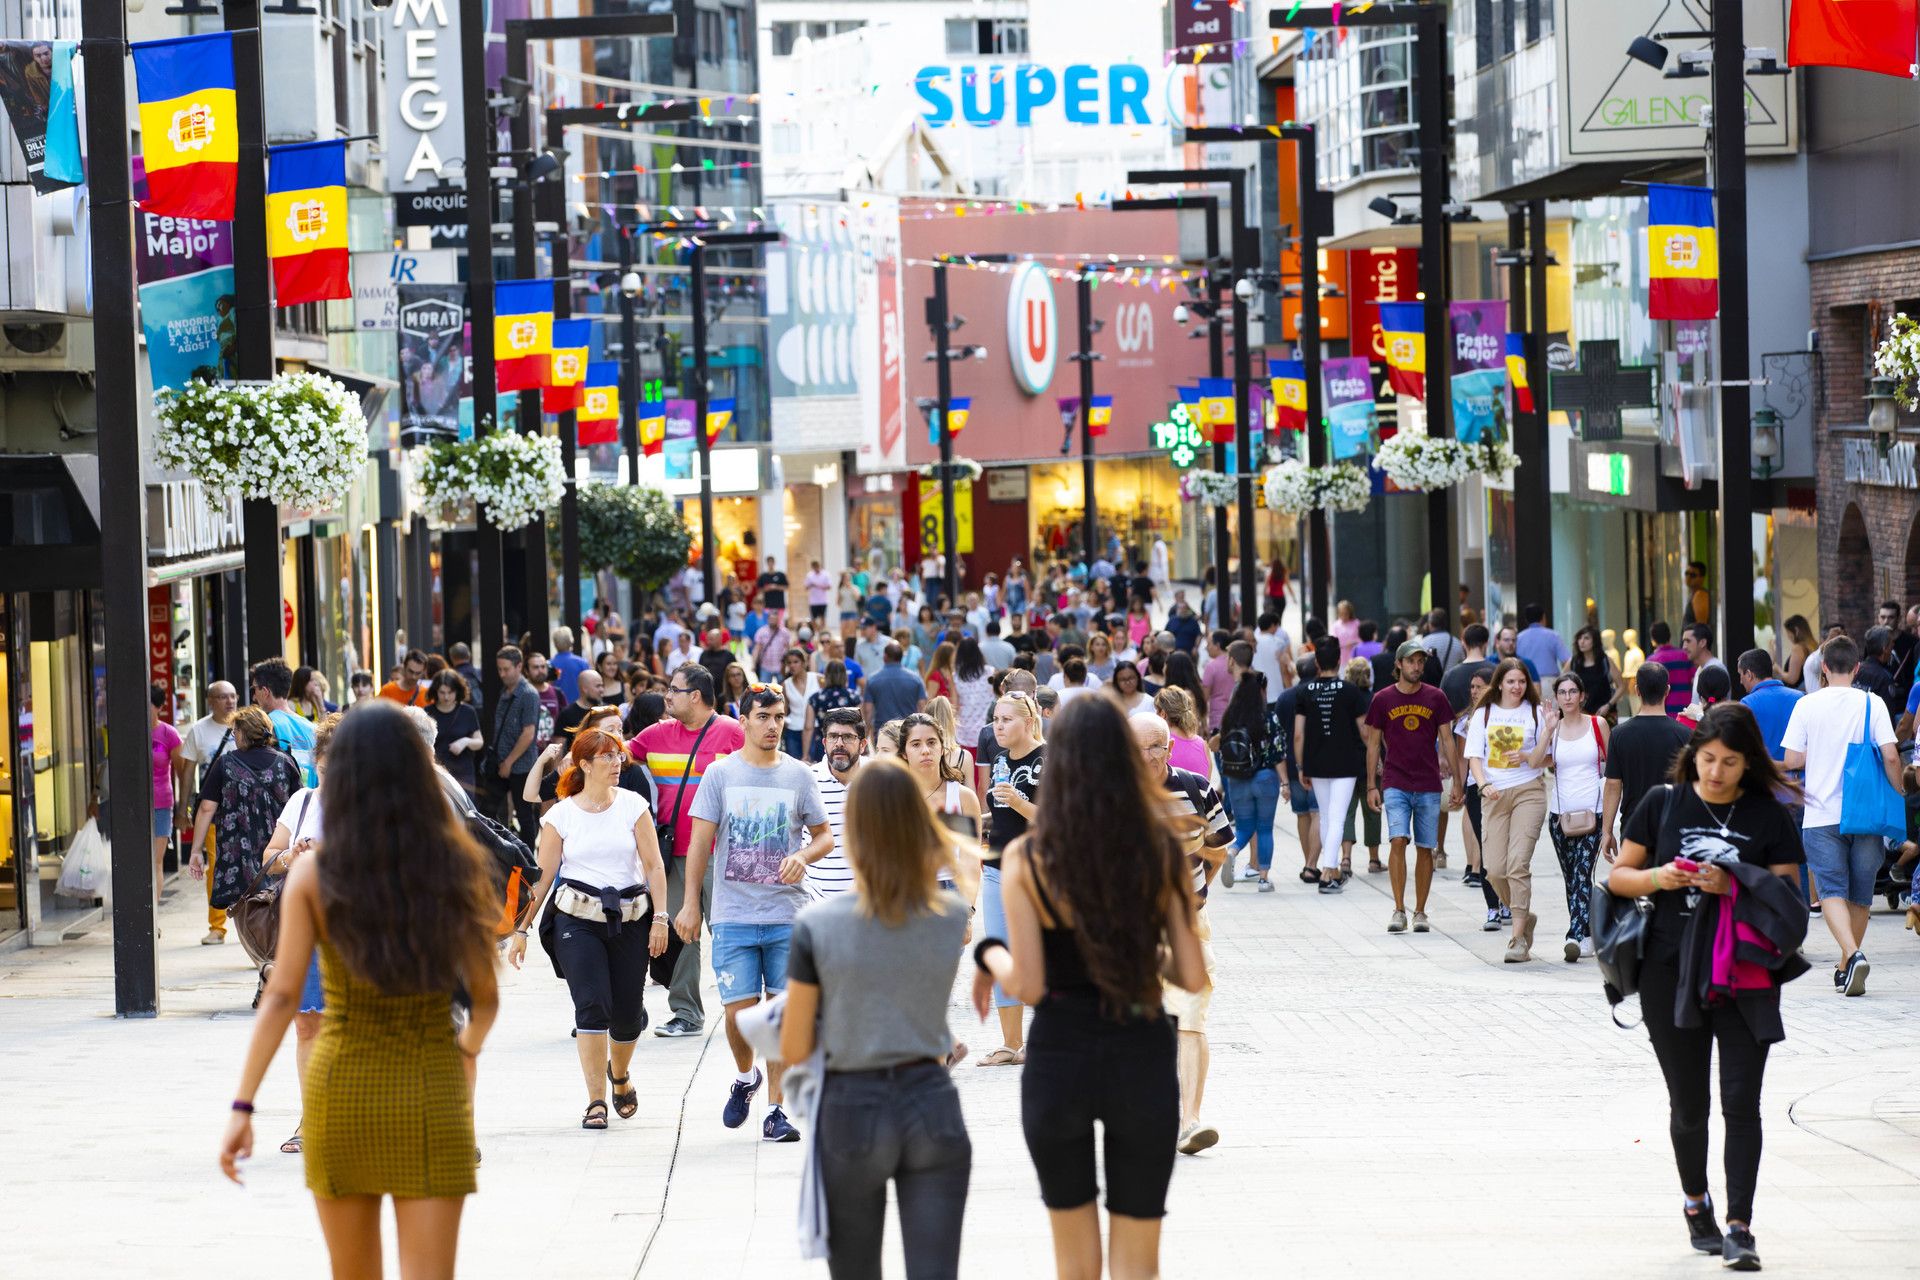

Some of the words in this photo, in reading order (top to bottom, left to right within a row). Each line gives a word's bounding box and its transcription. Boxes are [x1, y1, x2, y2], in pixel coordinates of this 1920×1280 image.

[914, 64, 1150, 128] SUPER
[26, 139, 47, 152] DILL
[144, 212, 218, 235] Festa
[146, 227, 219, 260] Major
[390, 253, 418, 282] IR
[168, 315, 217, 329] ANDORRA
[406, 311, 459, 328] MORAT
[168, 325, 182, 337] LA
[185, 323, 218, 336] VELLA
[1027, 300, 1047, 363] U
[178, 340, 211, 354] AGOST
[1456, 333, 1498, 347] Festa
[1457, 346, 1499, 363] Major
